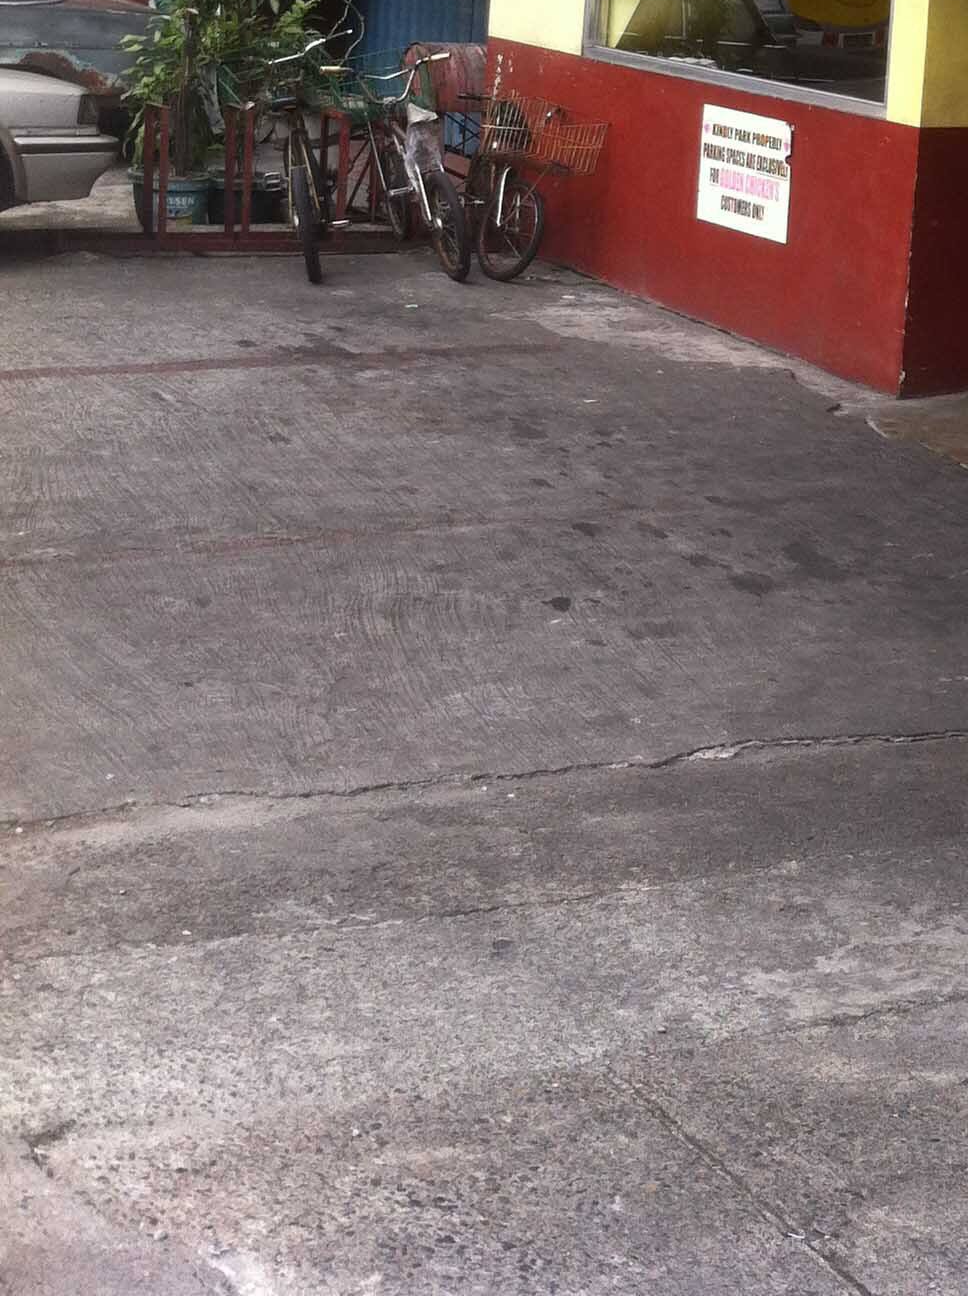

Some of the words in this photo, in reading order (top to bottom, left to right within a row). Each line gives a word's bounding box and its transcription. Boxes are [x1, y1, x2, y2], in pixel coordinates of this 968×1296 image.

[712, 123, 733, 139] KINDLY
[734, 127, 752, 144] PARK
[703, 142, 726, 163] PARKING
[745, 152, 757, 170] ARE
[710, 168, 719, 184] FOR
[721, 195, 751, 217] CUSTOMERS
